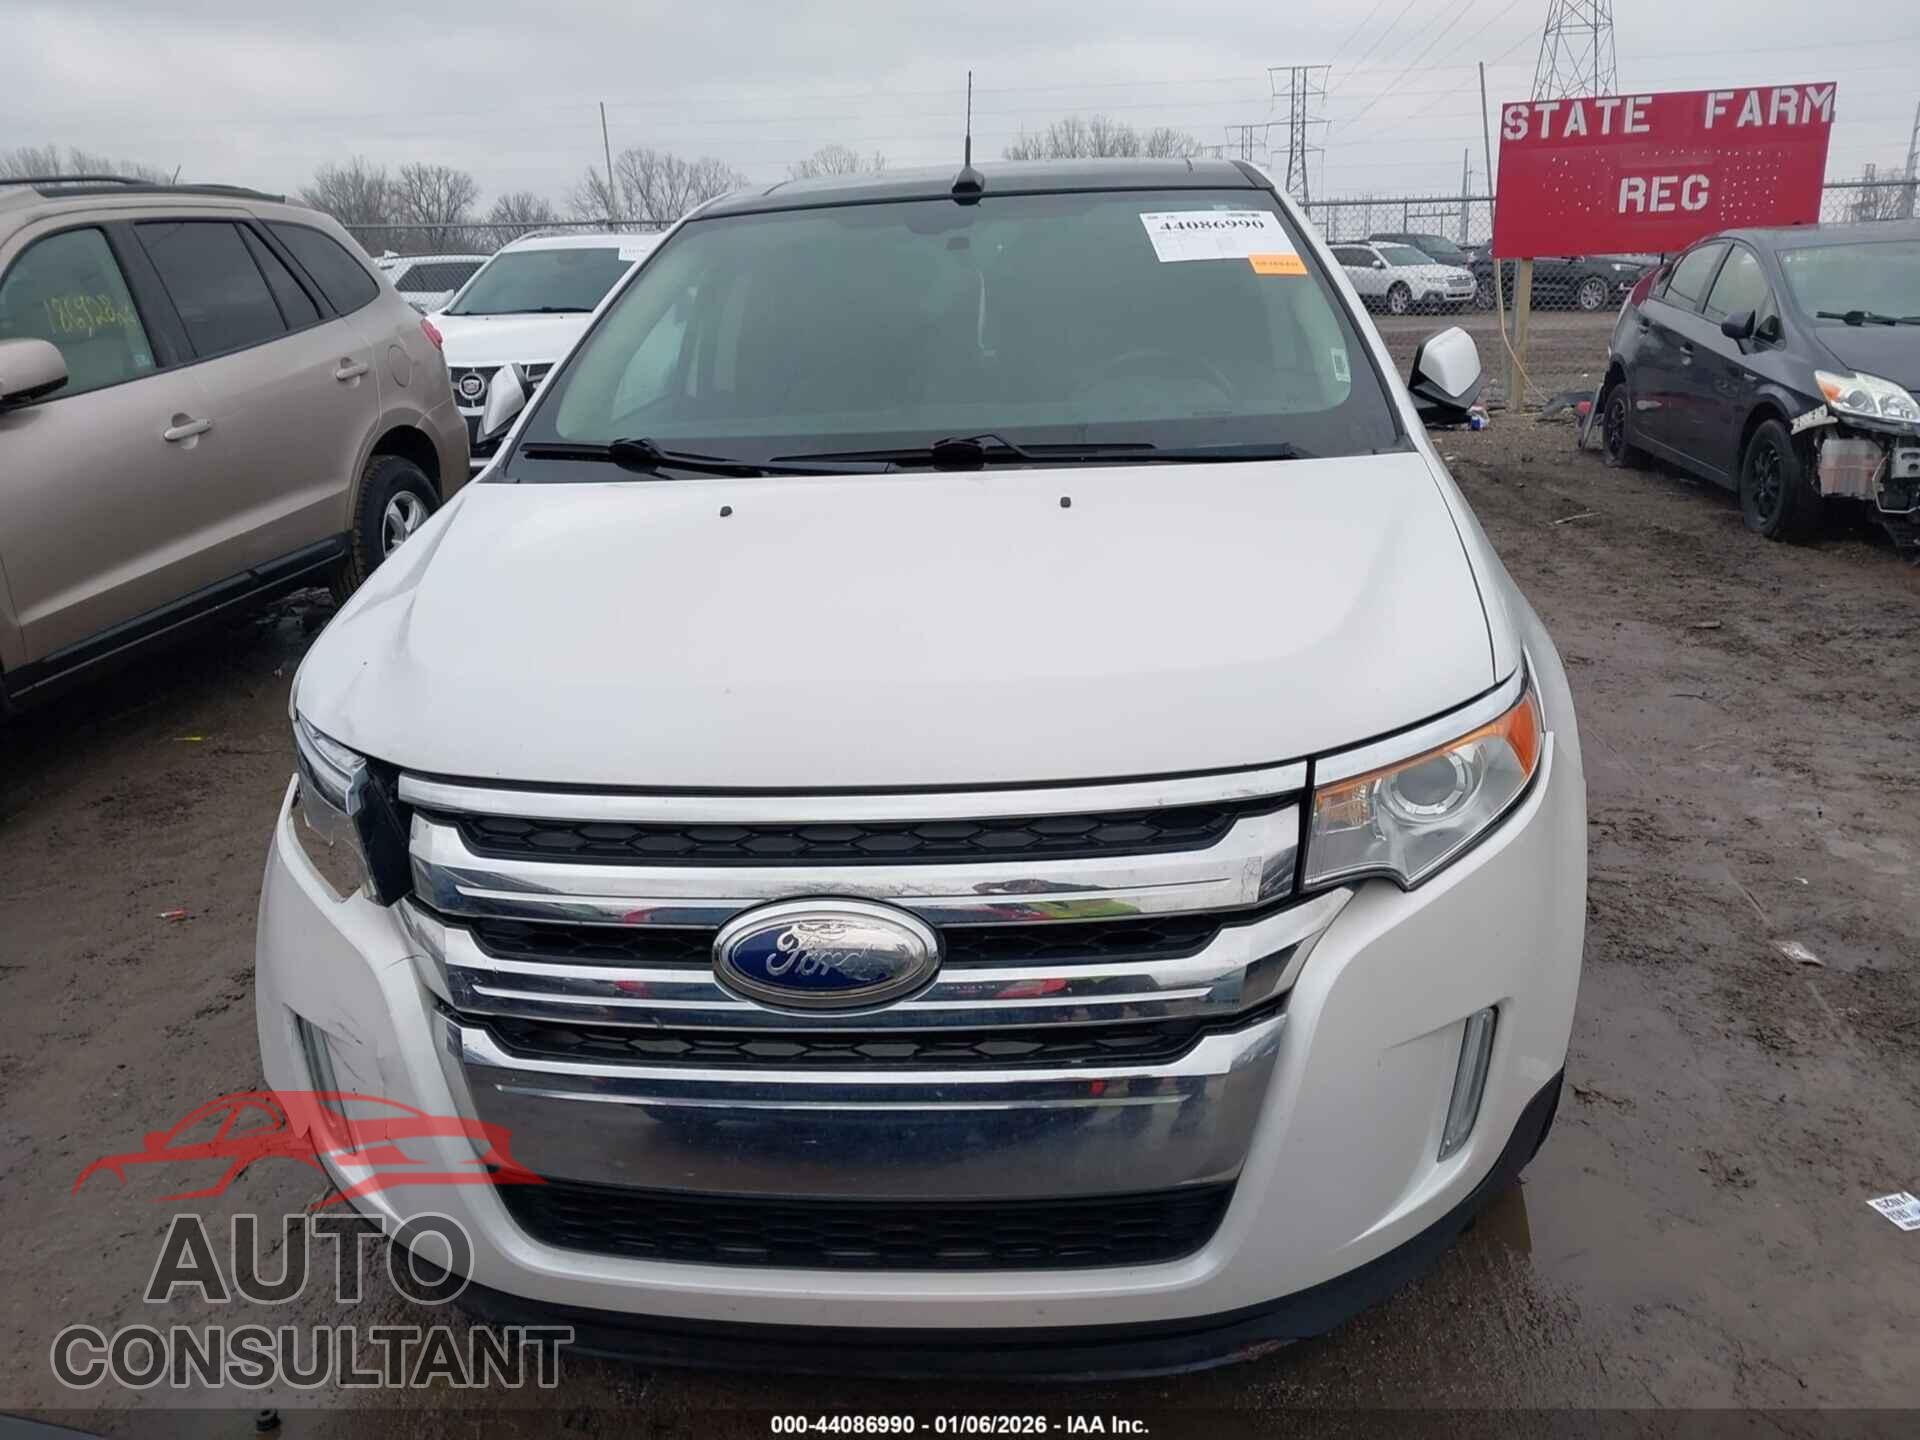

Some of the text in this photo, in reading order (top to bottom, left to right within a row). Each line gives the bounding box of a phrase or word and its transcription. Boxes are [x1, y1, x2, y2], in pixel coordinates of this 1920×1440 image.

[1502, 83, 1835, 141] STATE FARM
[1617, 173, 1710, 214] REG
[1160, 218, 1265, 232] 44086990
[766, 923, 905, 981] Ford
